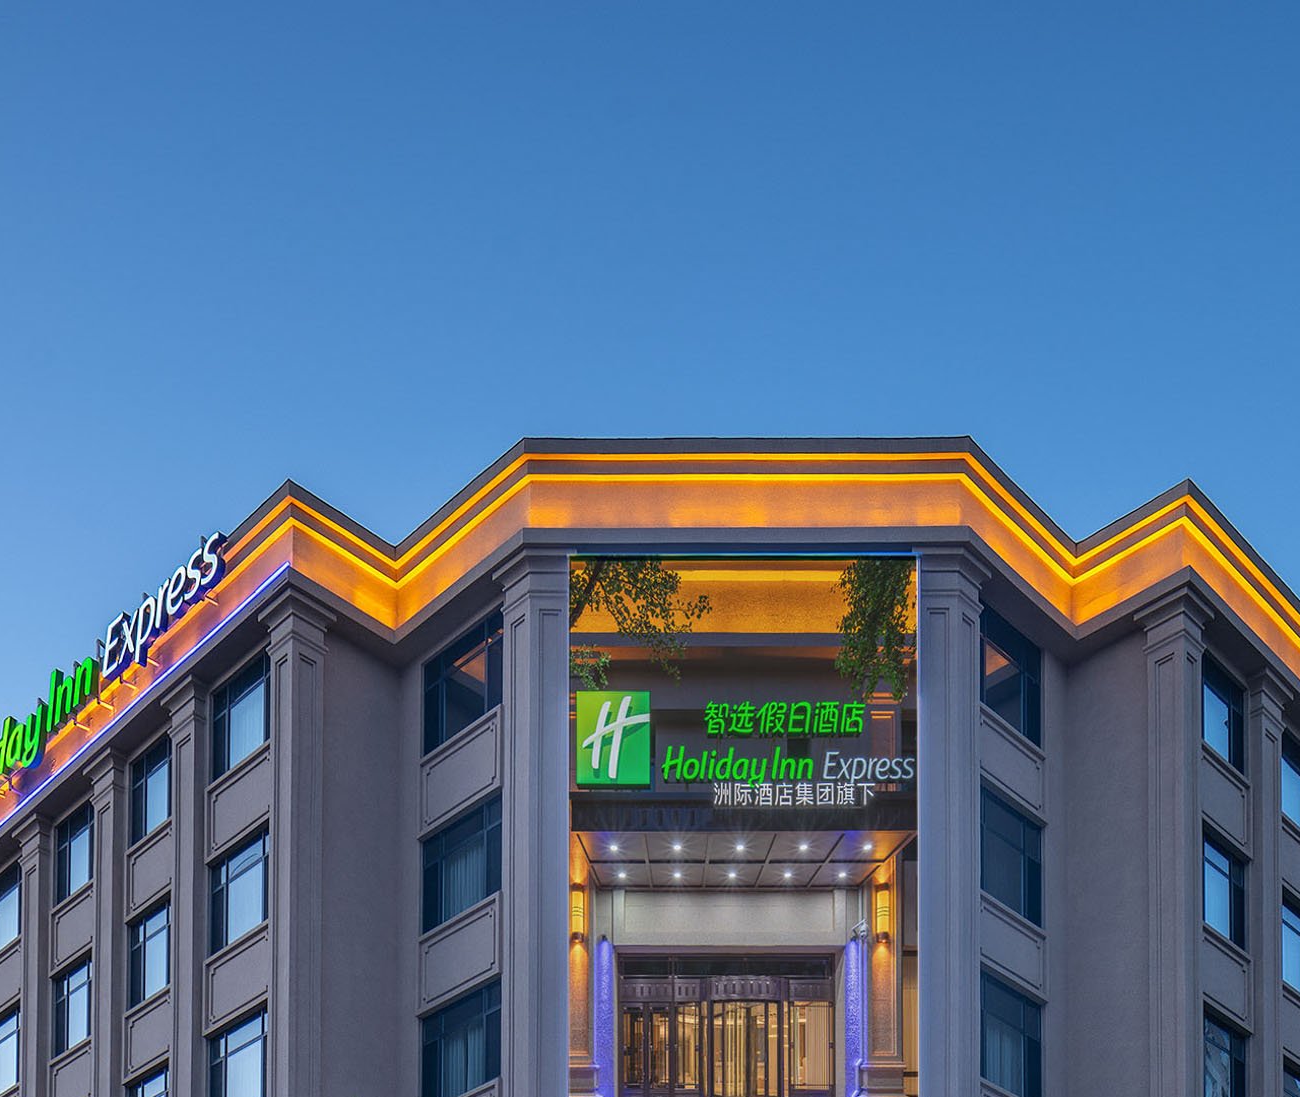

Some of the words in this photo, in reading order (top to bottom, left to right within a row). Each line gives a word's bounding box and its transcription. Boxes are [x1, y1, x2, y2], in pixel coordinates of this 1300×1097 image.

[46, 656, 99, 732] Inn
[102, 531, 227, 680] Express
[705, 700, 866, 734] 智选假日酒店
[662, 745, 766, 787] Holiday
[772, 746, 813, 780] Inn
[823, 751, 915, 784] Express
[713, 782, 875, 806] 洲际酒店集团旗下
